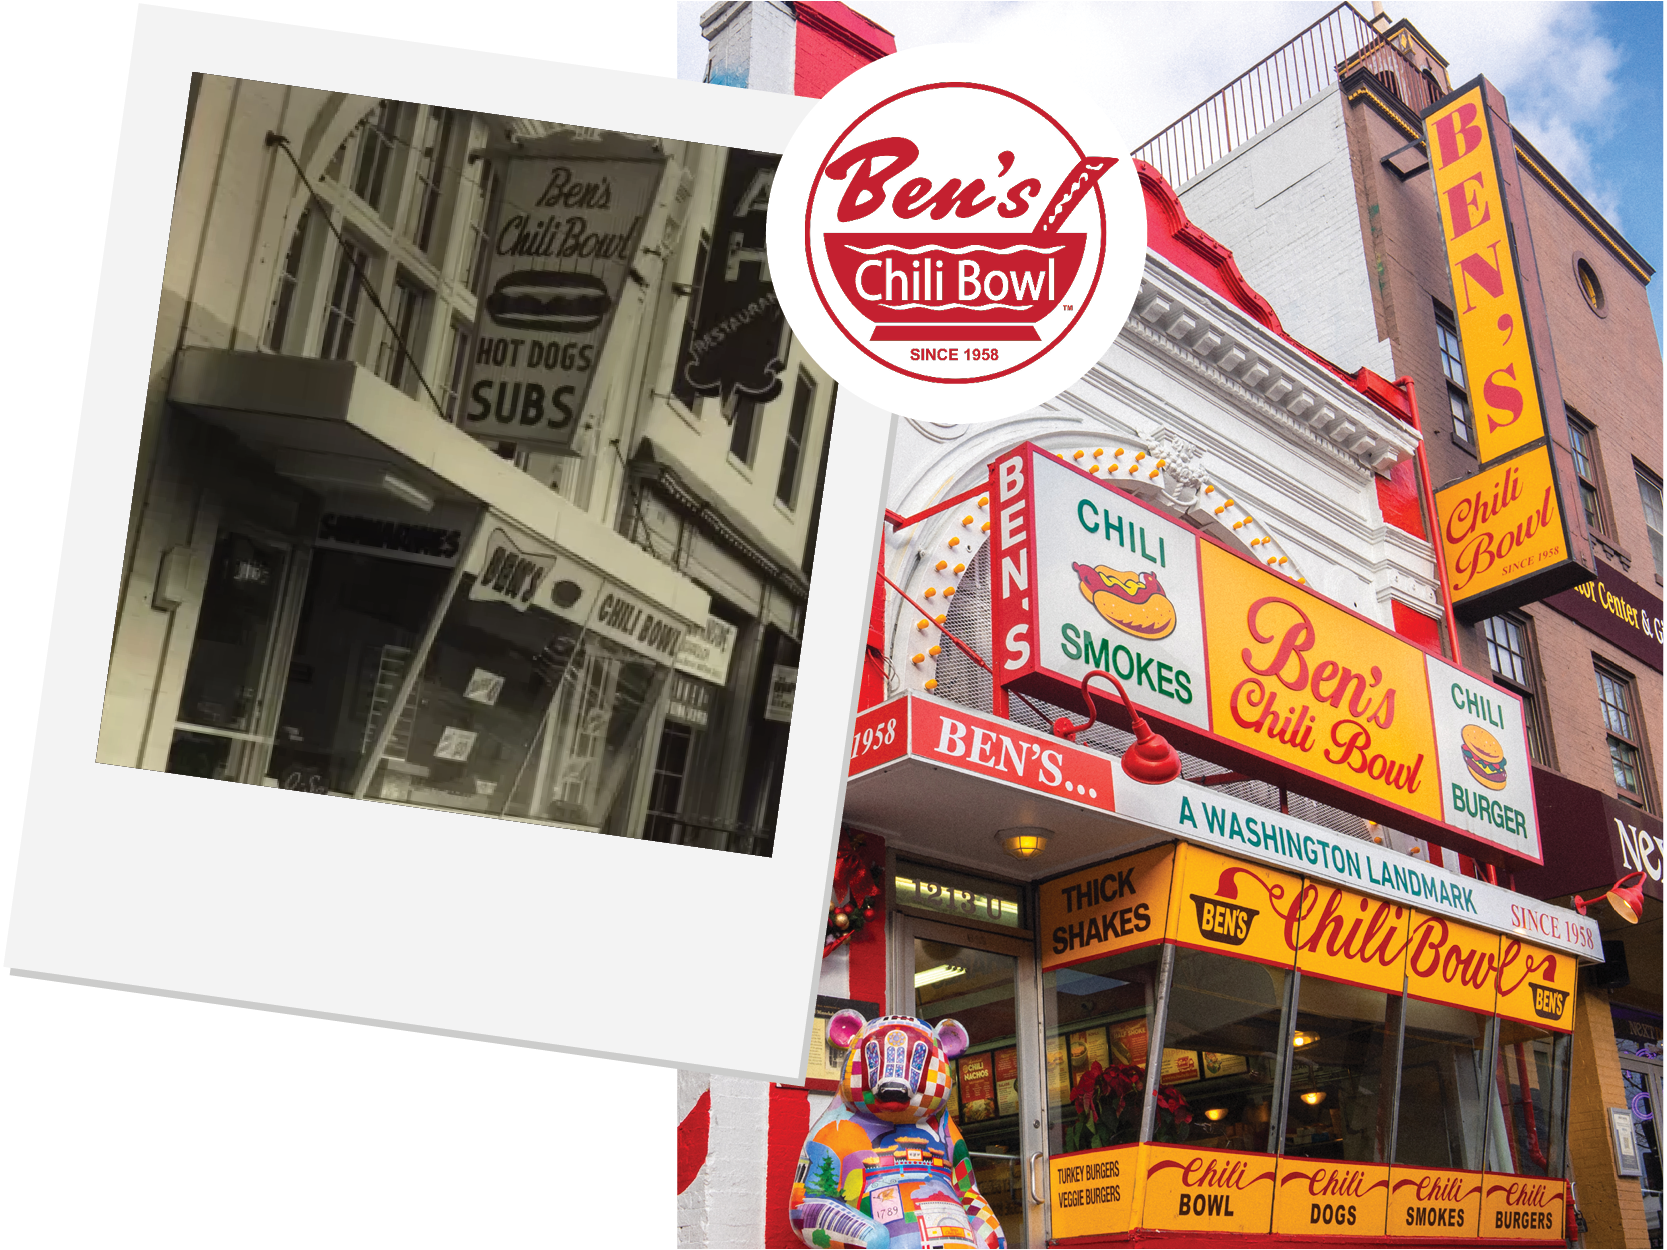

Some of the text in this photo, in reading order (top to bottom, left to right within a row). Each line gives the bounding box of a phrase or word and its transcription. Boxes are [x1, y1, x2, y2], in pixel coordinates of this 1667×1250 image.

[535, 166, 612, 210] Ben's
[496, 215, 643, 261] Chili Bowl
[1431, 101, 1524, 434] BEN'S
[693, 289, 778, 354] RESTAURAN
[475, 338, 595, 373] HOT DOGS
[466, 379, 576, 429] SUBS
[1446, 466, 1524, 545] Chili
[1077, 498, 1167, 568] CHILI
[1453, 485, 1554, 591] Bowl
[999, 455, 1031, 671] BEN'S
[1502, 545, 1560, 576] SINCE 1958
[597, 593, 643, 636] CHILI
[1597, 581, 1640, 630] Center
[1641, 609, 1654, 639] &
[1061, 622, 1193, 704] SMOKES
[1241, 596, 1397, 729] Ben's
[1451, 683, 1504, 730] CHILI
[851, 718, 897, 760] 1958
[934, 715, 1098, 799] BEN'S...
[1230, 677, 1424, 794] Chili Bowl
[1451, 782, 1528, 839] BURGER
[1179, 796, 1478, 914] A WASHINGTON LANDMARK
[912, 878, 976, 915] 1213
[1061, 866, 1137, 914] THICK
[1052, 902, 1151, 955] SHAKES
[1202, 902, 1248, 940] BEN'S
[1283, 884, 1524, 997] Chili Bowl
[1511, 904, 1595, 951] SINCE 1958
[1535, 989, 1565, 1017] BEN'S
[963, 1069, 989, 1082] NACHOS
[967, 1061, 984, 1072] CHILI
[1057, 1160, 1120, 1185] TURKEY BURGERS
[1180, 1157, 1254, 1191] Chili
[1307, 1168, 1368, 1198] Chili
[1415, 1175, 1468, 1203] Chili
[876, 1205, 899, 1219] 1789
[1058, 1184, 1121, 1209] VEGGIE BURGERS
[1178, 1193, 1235, 1217] BOWL
[1310, 1203, 1357, 1226] DOGS
[1405, 1206, 1465, 1228] SMOKES
[1505, 1182, 1552, 1209] Chili
[1495, 1211, 1553, 1230] BURGERS
